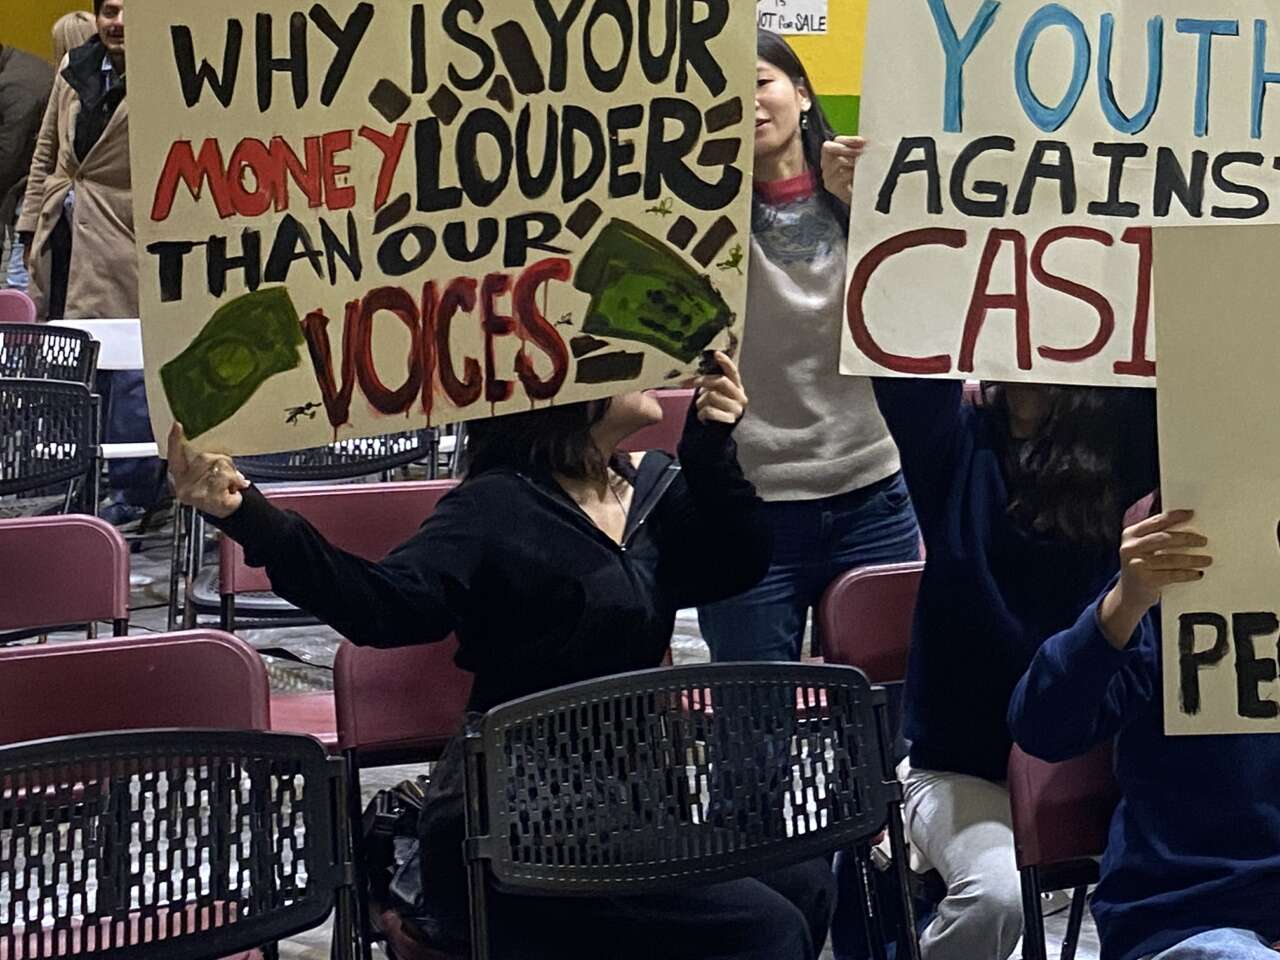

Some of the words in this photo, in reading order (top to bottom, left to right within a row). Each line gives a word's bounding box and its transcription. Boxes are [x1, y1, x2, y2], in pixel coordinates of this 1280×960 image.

[170, 2, 373, 111] WHY
[795, 13, 826, 31] SALE
[150, 123, 411, 222] MONEY
[413, 97, 742, 212] LOUDER
[146, 210, 363, 302] THAN
[376, 211, 572, 275] OUR
[846, 226, 1157, 375] CASI
[300, 257, 572, 427] VOICES
